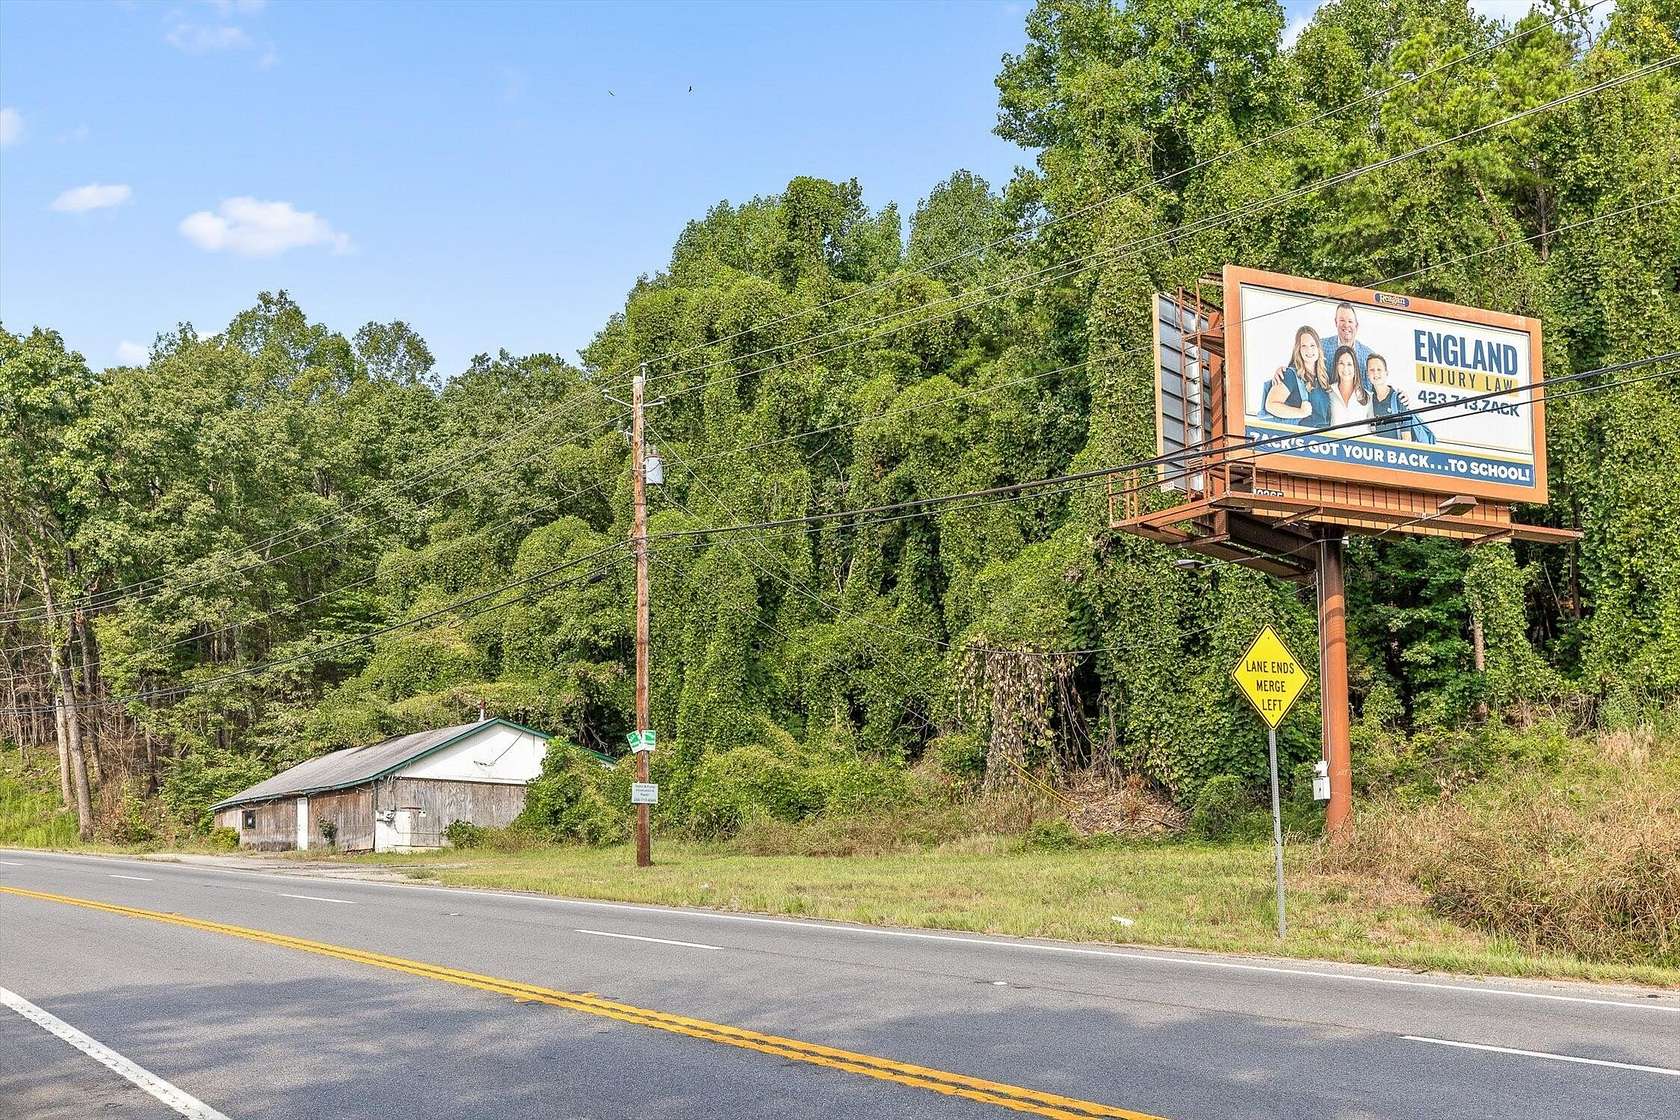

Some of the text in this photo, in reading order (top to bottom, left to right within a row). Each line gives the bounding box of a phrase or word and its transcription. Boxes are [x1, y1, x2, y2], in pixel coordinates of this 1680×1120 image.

[1414, 329, 1518, 375] ENGLAND
[1422, 366, 1513, 392] INJURY LAW
[1418, 390, 1520, 417] 423713.ZACK
[1249, 431, 1306, 452] ZACK'S
[1308, 440, 1340, 456] GOT
[1342, 444, 1384, 462] YOUR
[1470, 462, 1531, 481] SCHOOL!
[1246, 660, 1295, 674] LANE ENDS
[1256, 680, 1286, 692] MERGE
[1262, 699, 1282, 711] LEFT
